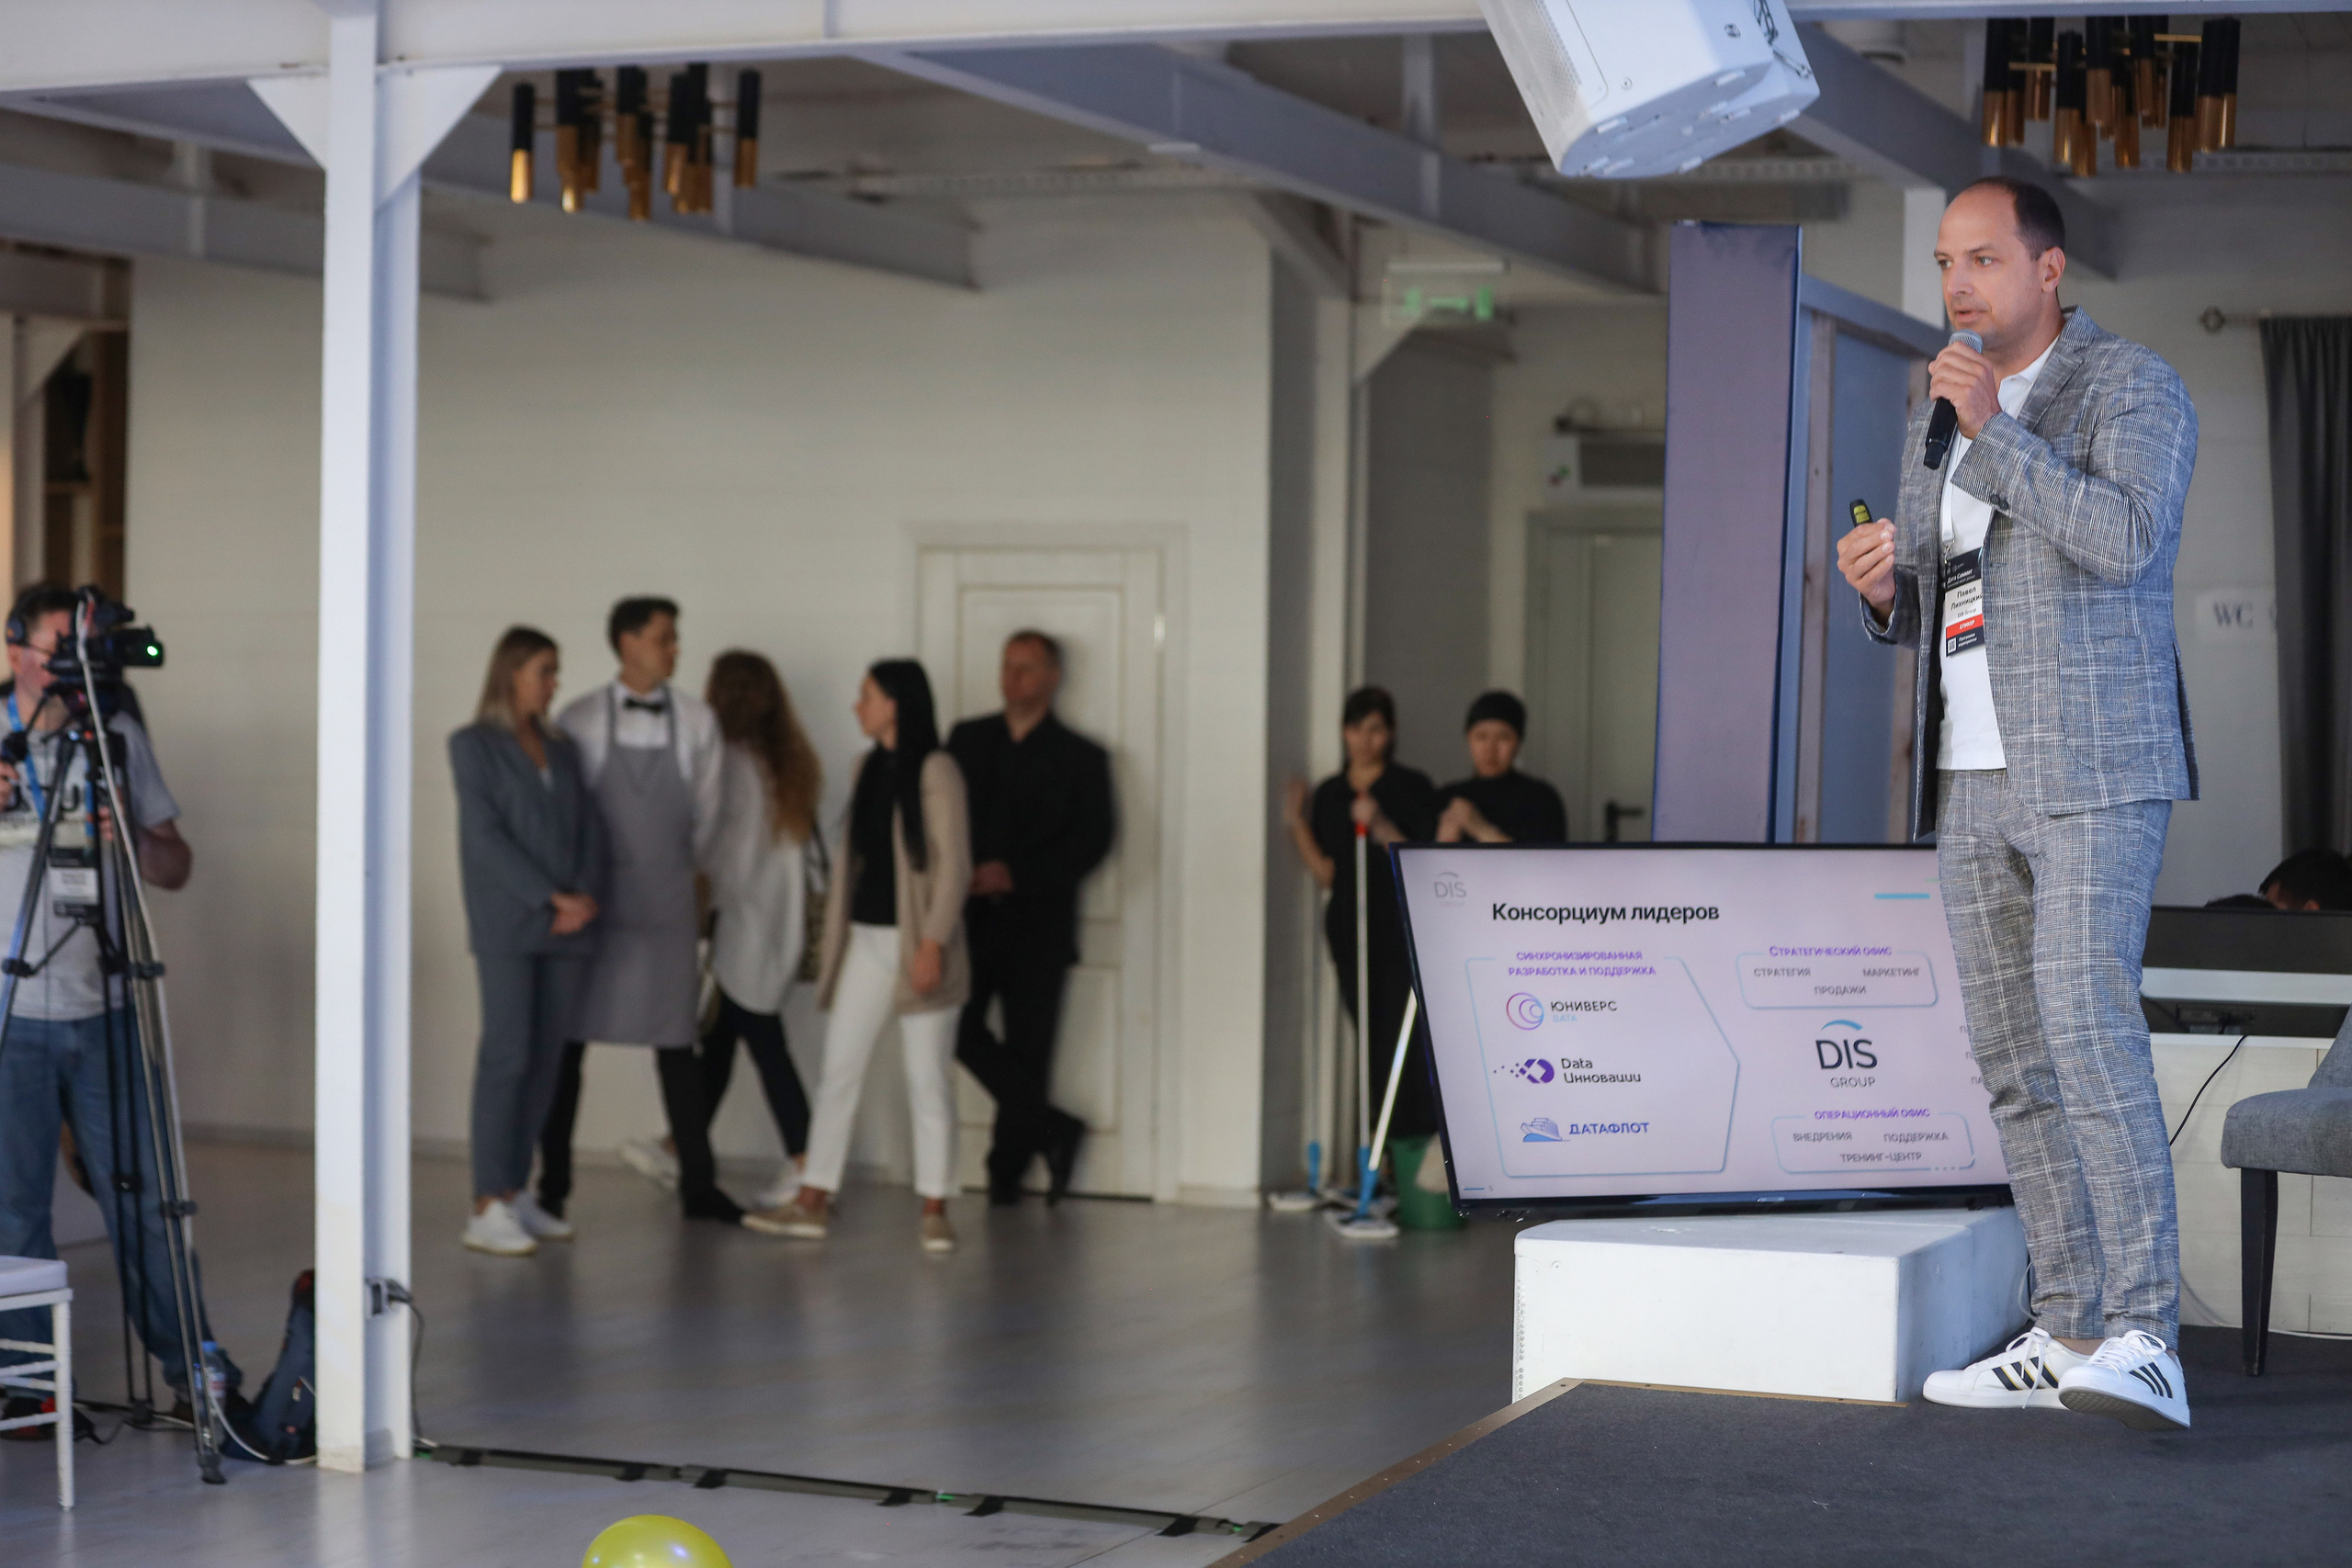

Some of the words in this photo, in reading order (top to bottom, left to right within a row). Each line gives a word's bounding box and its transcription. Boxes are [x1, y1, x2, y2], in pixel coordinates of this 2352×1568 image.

[1957, 587, 1976, 599] Павел
[2213, 602, 2254, 628] WC
[1434, 882, 1467, 898] DIS
[1492, 903, 1626, 924] Консорциум
[1631, 904, 1720, 924] лидеров
[1516, 951, 1643, 962] СИНХРОНИЗИРОВАННАЯ
[1508, 966, 1577, 977] РАЗРАБОТКА
[1578, 966, 1587, 976] И
[1589, 965, 1657, 977] ПОДДЕРЖКА
[1753, 967, 1811, 977] СТРАТЕГИЯ
[1862, 967, 1920, 977] МАРКЕТИНГ
[1815, 986, 1867, 996] ПРОДАЖИ
[1550, 1000, 1618, 1012] ЮНИВЕРС
[1815, 1039, 1878, 1070] DIS
[1561, 1058, 1593, 1069] Data
[1564, 1072, 1642, 1084] Инновации
[1830, 1077, 1876, 1088] GROUP
[1815, 1108, 1899, 1121] ОПЕРАЦИОННЫЙ
[1900, 1108, 1930, 1118] ОФИС
[1569, 1122, 1650, 1135] ДАТАФЛОТ
[1793, 1132, 1852, 1143] ВНЕДРЕНИЯ
[1883, 1132, 1949, 1144] ПОДДЕРЖКА
[1840, 1152, 1923, 1164] ТРЕНИНГ-ЦЕНТР
